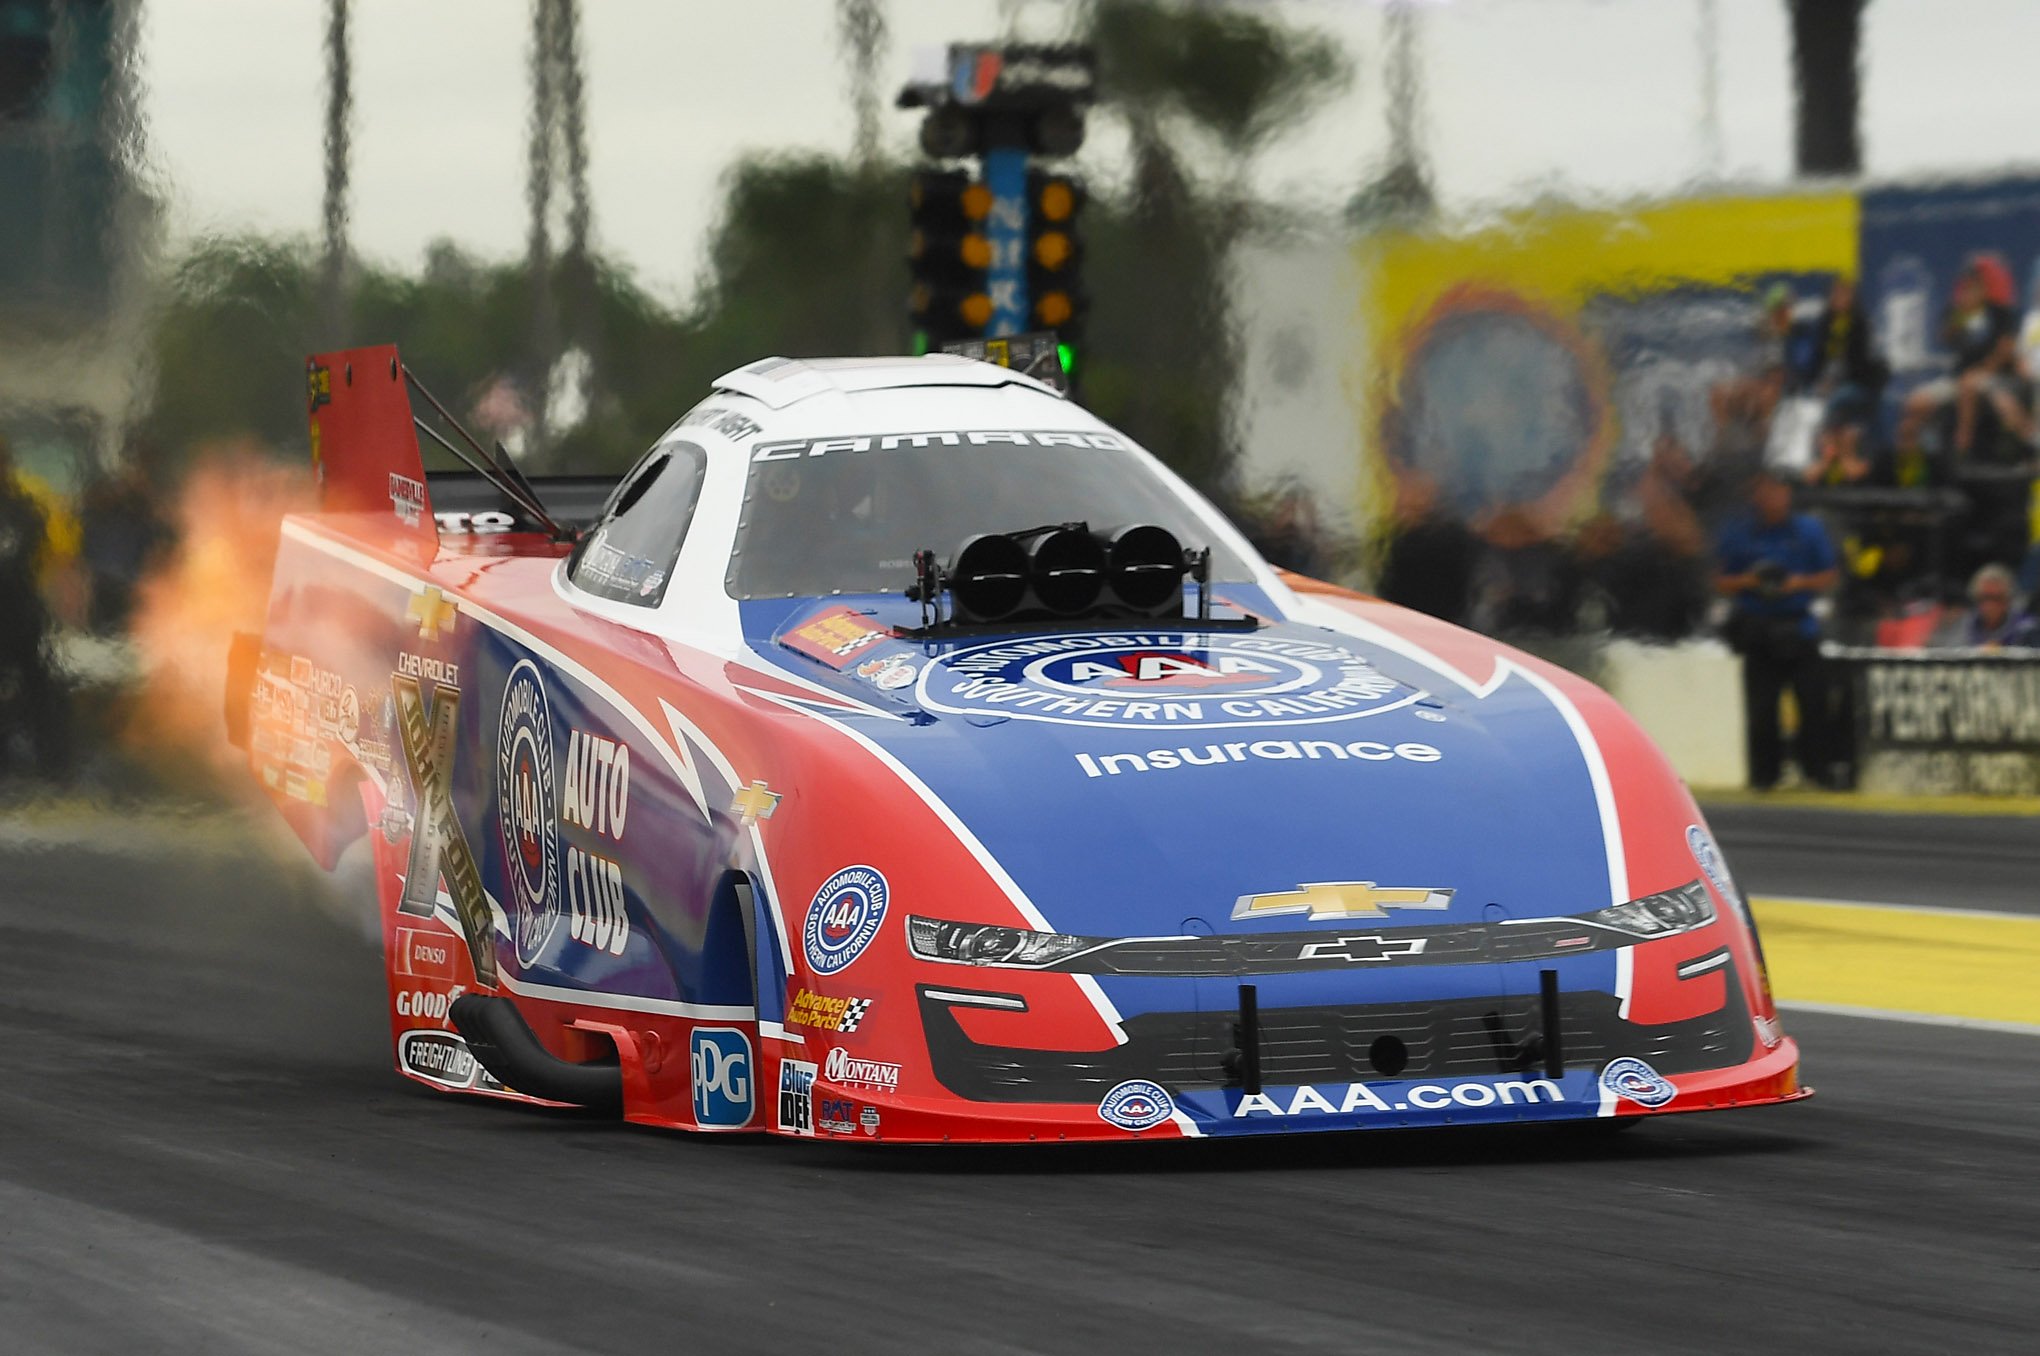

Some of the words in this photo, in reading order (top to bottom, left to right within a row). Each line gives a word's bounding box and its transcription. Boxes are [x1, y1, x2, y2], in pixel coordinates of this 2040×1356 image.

[752, 431, 1127, 463] CAMARO
[399, 651, 459, 685] CHEVROLET
[1072, 656, 1282, 681] AAA
[951, 677, 1204, 720] SOUTHERN
[536, 711, 551, 793] CLUB
[1074, 739, 1442, 778] Insurance
[563, 729, 630, 840] AUTO
[515, 772, 541, 844] AAA
[567, 846, 630, 956] CLUB
[817, 871, 875, 907] AUTOMOBILE
[868, 882, 883, 911] CLUB
[823, 903, 861, 929] AAA
[415, 945, 446, 965] DENSO
[806, 914, 827, 968] SOUTHERN
[826, 918, 879, 969] CALIFORNIA
[787, 1007, 809, 1025] Auto
[807, 1011, 837, 1031] Parts
[794, 988, 845, 1013] Advance
[409, 1041, 474, 1076] FREIGHTLINER
[780, 1092, 810, 1130] DEF
[1120, 1104, 1153, 1114] AAA
[1233, 1078, 1565, 1118] AAA.com
